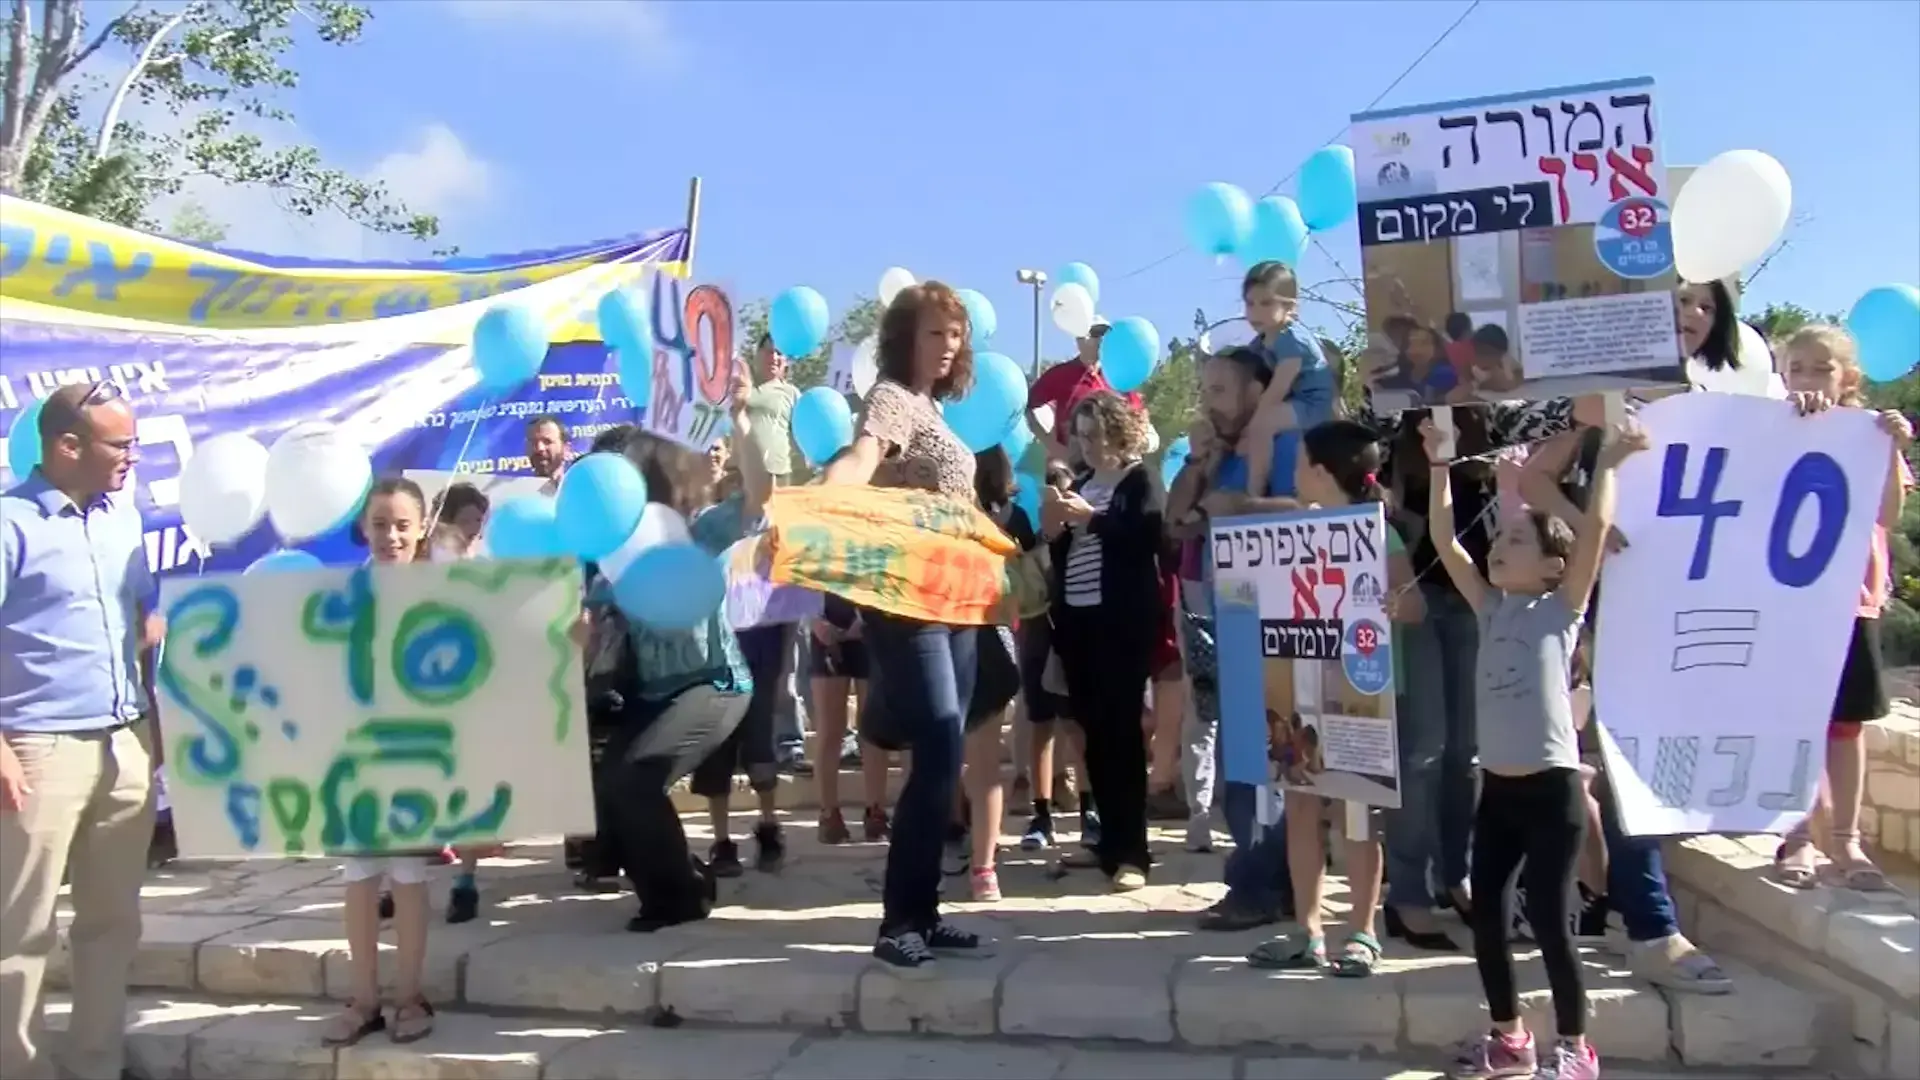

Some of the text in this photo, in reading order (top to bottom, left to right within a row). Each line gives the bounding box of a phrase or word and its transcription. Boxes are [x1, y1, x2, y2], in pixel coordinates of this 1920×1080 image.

[1438, 92, 1654, 169] המורה
[1374, 184, 1536, 245] לי מקום
[1538, 144, 1659, 225] אין
[1623, 207, 1653, 230] 32
[650, 267, 734, 406] 40
[1214, 518, 1379, 570] אם צפופים
[1656, 442, 1850, 589] 40
[1290, 545, 1346, 623] לא
[302, 567, 495, 708] 40
[1263, 618, 1341, 657] לומדים
[1357, 627, 1376, 649] 32
